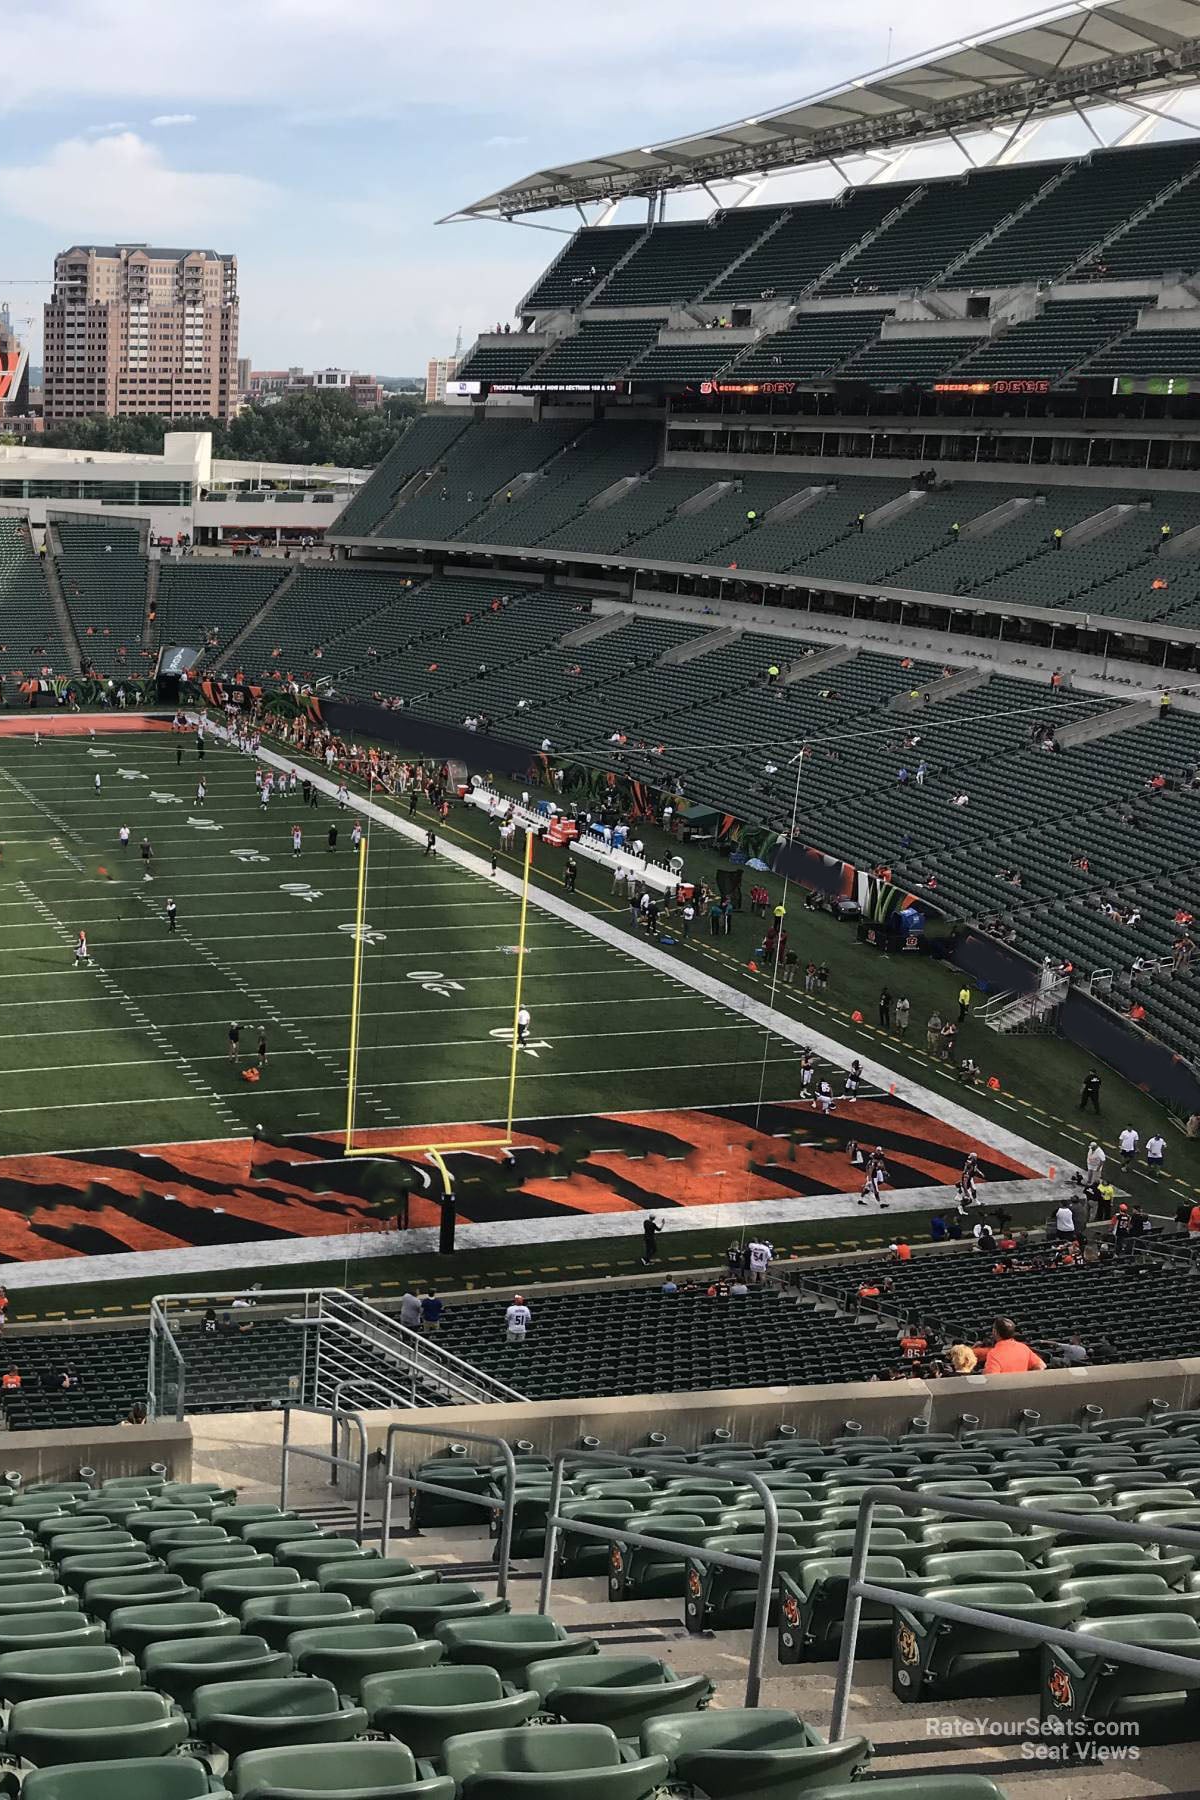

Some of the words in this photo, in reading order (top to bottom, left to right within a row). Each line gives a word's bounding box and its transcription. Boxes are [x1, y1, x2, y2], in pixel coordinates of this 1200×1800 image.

[762, 382, 796, 394] DEY
[229, 848, 271, 862] 50
[337, 923, 387, 941] 30
[406, 971, 466, 991] 20
[515, 1315, 525, 1326] 51
